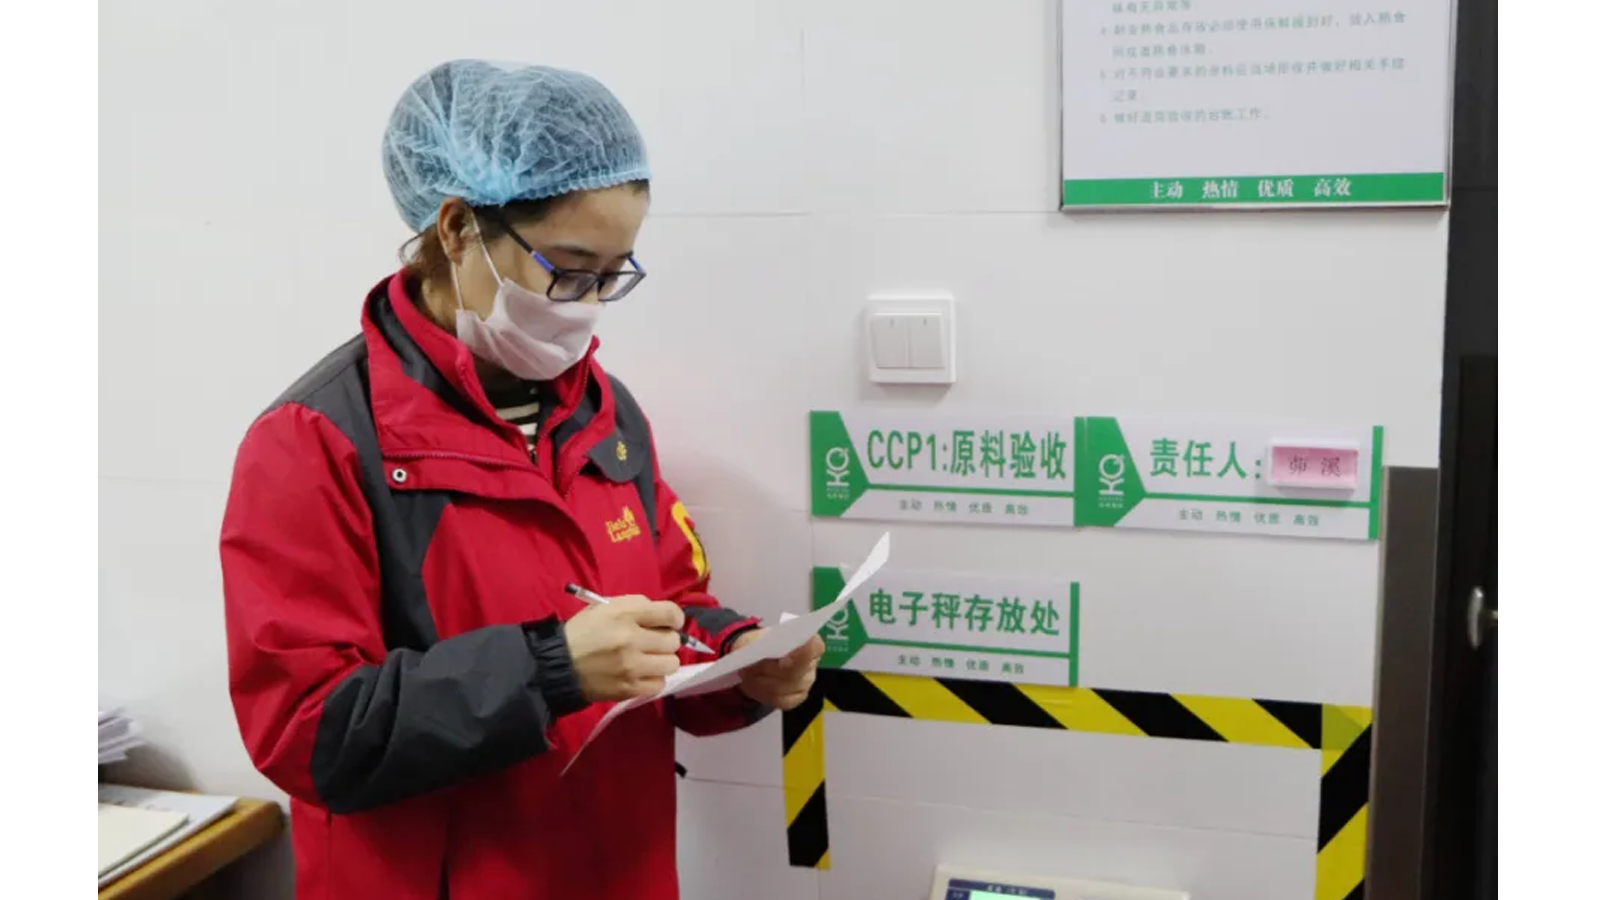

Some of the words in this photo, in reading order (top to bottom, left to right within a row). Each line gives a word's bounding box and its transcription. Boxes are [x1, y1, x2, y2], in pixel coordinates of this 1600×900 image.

[1152, 181, 1184, 199] 主动
[1202, 180, 1238, 198] 热情
[1258, 178, 1294, 197] 优质
[1314, 177, 1352, 197] 高效
[899, 500, 922, 511] 主动
[933, 501, 957, 512] 热情
[968, 502, 993, 514] 优质
[1005, 503, 1029, 515] 高效
[1179, 508, 1203, 521] 主动
[1216, 510, 1241, 523] 热情
[1254, 512, 1281, 525] 优质
[1293, 514, 1320, 526] 高效
[869, 588, 1060, 636] 电子秤存放处
[898, 654, 921, 667] 主动
[931, 656, 955, 669] 热情
[966, 658, 990, 671] 优质
[1001, 661, 1025, 674] 高效
